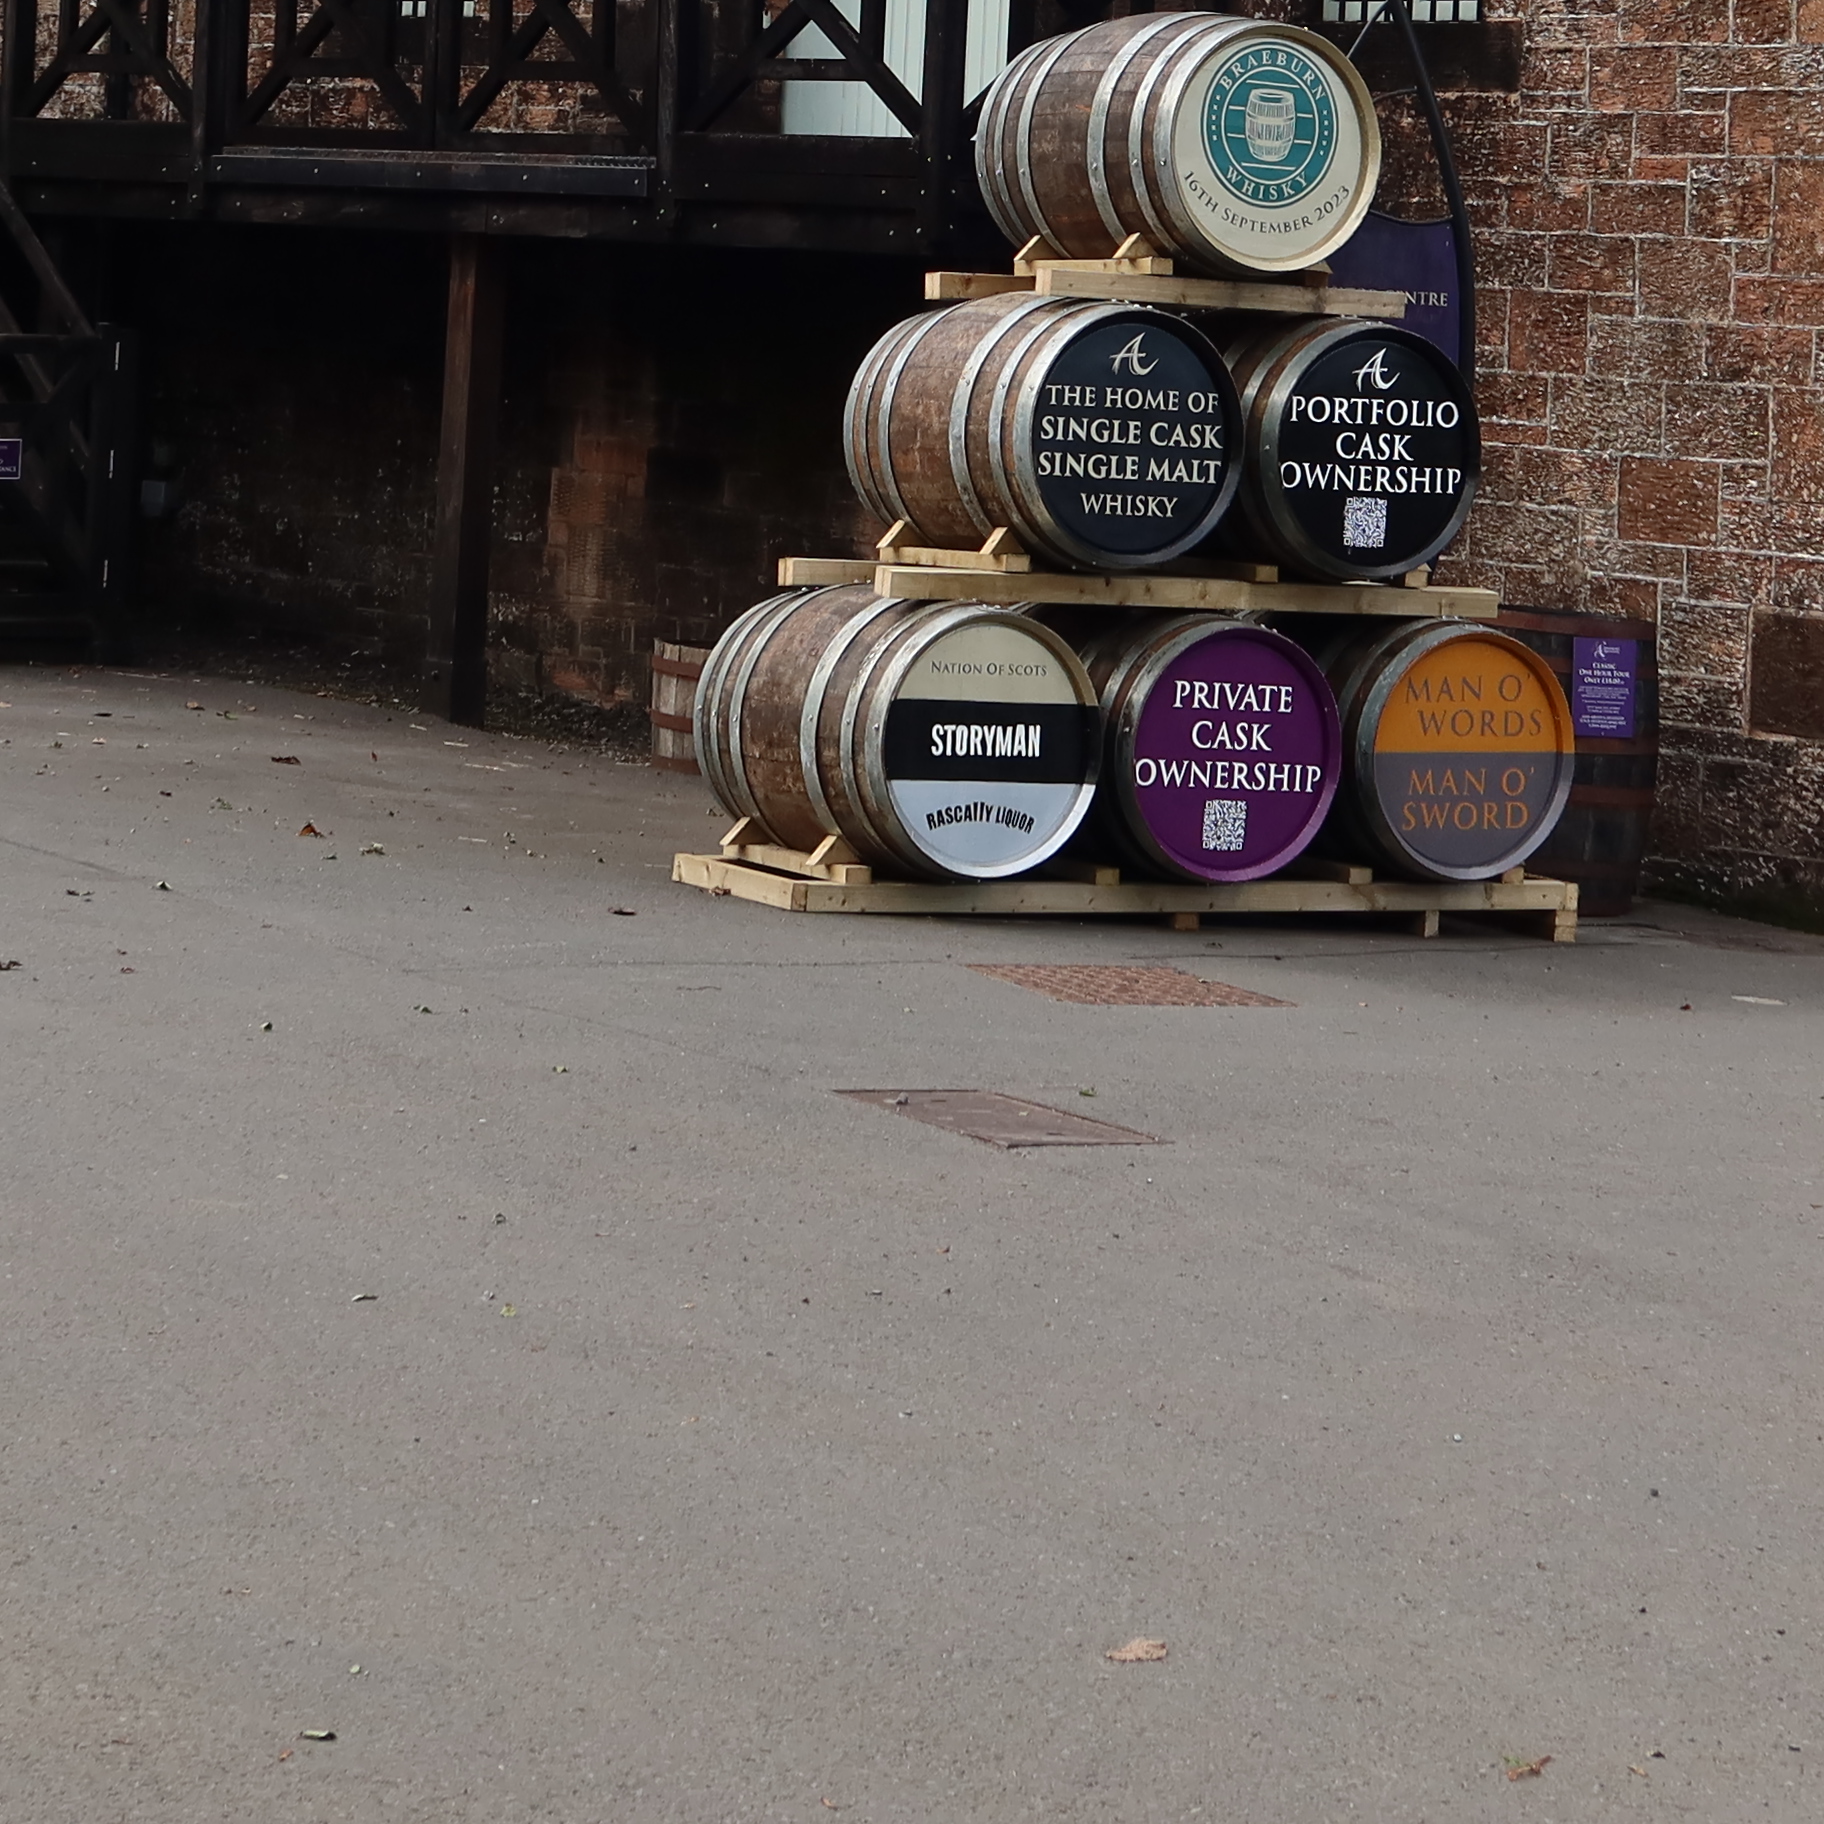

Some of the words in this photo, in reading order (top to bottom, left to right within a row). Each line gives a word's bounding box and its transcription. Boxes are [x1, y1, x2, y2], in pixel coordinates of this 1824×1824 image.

[1219, 49, 1325, 101] BRAEBURN
[1226, 165, 1309, 200] WHISKY
[1183, 170, 1219, 214] 16TH
[1221, 207, 1313, 234] SEPTEMBER
[1314, 185, 1350, 221] 2023
[1404, 290, 1448, 307] NTRE
[1046, 384, 1097, 407] THE
[1104, 386, 1179, 411] HOME
[1187, 391, 1219, 414] OF
[1290, 395, 1459, 428] PORTFOLIO
[1040, 415, 1142, 445] SINGLE
[1149, 422, 1223, 449] CASK
[1335, 432, 1414, 461] CASK
[1038, 451, 1140, 480] SINGLE
[1145, 457, 1222, 484] MALT
[1280, 461, 1461, 495] OWNERSHIP
[1080, 492, 1178, 518] WHISKY
[931, 660, 982, 674] NATION
[987, 662, 1005, 676] OF
[1008, 663, 1047, 676] SCOTS
[1172, 680, 1293, 713] PRIVATE
[1404, 676, 1482, 703] MAN
[1498, 674, 1531, 702] O'
[1191, 720, 1272, 751] CASK
[1417, 709, 1542, 737] WORDS
[931, 724, 1041, 758] STORYMAN
[1135, 758, 1321, 793] OWNERSHIP
[1408, 768, 1487, 795] MAN
[1501, 766, 1535, 796] O'
[995, 806, 1035, 835] LIQUOR
[1402, 801, 1529, 830] SWORD
